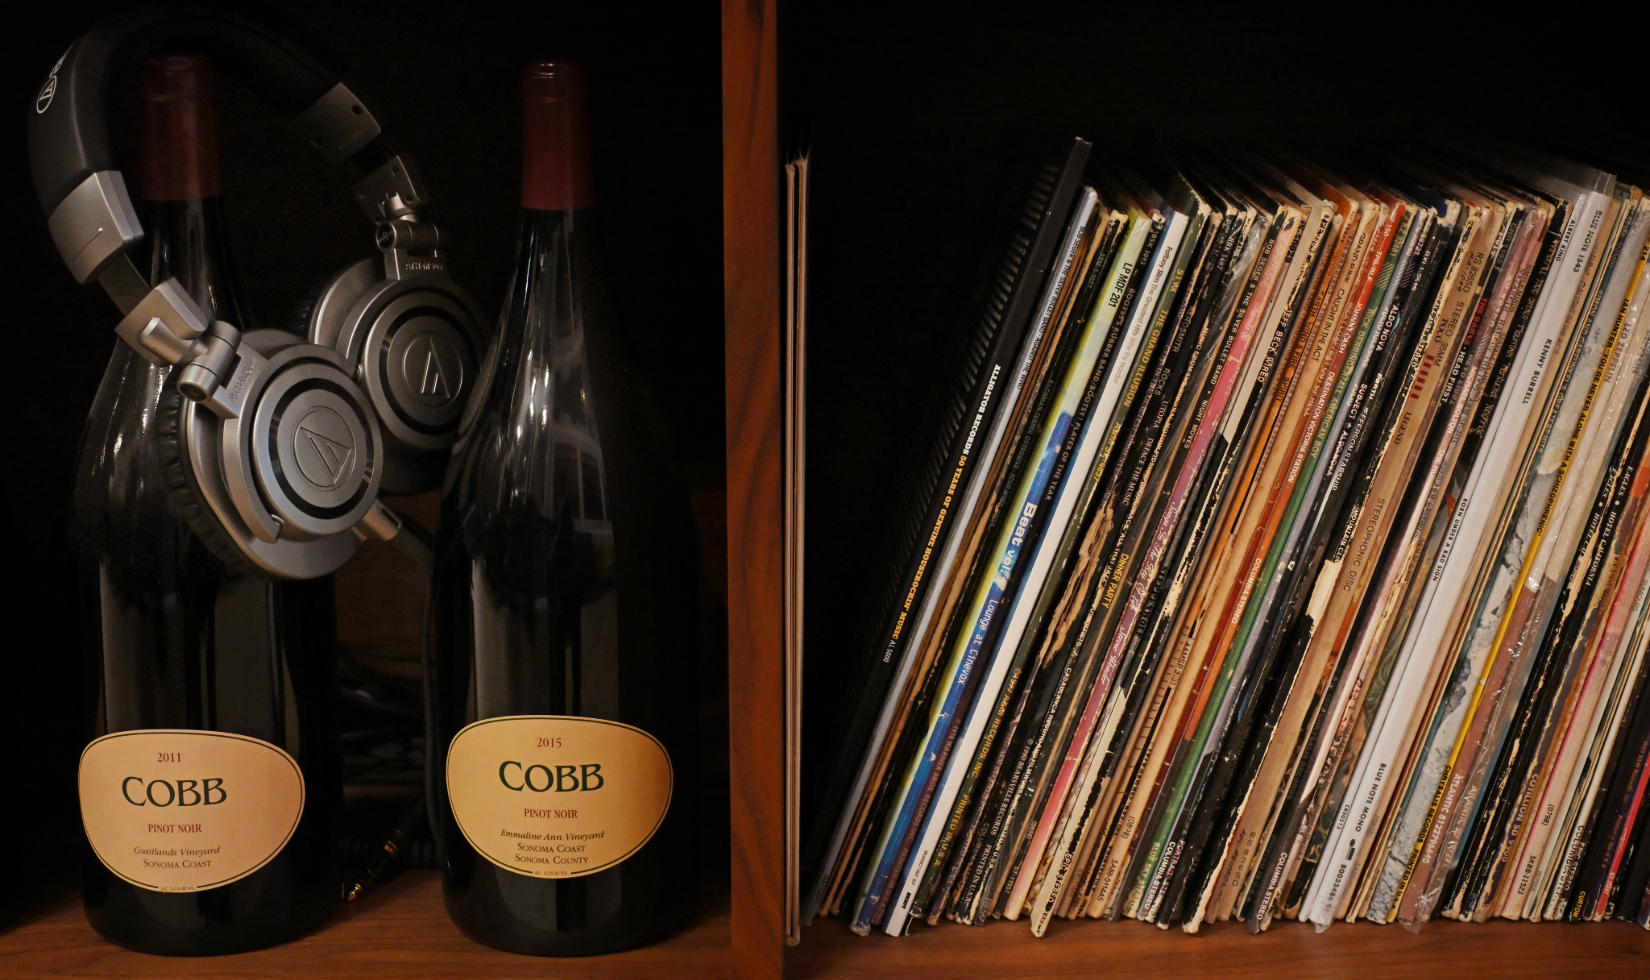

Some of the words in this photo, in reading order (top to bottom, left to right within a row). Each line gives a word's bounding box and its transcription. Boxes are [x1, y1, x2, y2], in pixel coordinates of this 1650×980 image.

[1561, 218, 1576, 244] ALBERT
[1588, 208, 1603, 231] BLUE
[1157, 244, 1173, 269] Fatboy
[1263, 237, 1275, 255] BOB
[1471, 250, 1484, 265] RS
[1554, 243, 1567, 263] KING
[1120, 261, 1133, 274] LP
[1214, 251, 1228, 271] 3487
[1251, 255, 1268, 282] SEGER
[1571, 253, 1586, 274] 1543
[1112, 272, 1129, 294] MDF
[1147, 282, 1158, 296] The
[1152, 267, 1164, 284] Slim
[1168, 267, 1185, 294] STYX
[1248, 282, 1256, 290] &
[1460, 264, 1478, 294] 826SD
[1107, 291, 1121, 308] 201
[1136, 295, 1153, 325] Greatest
[1241, 289, 1253, 307] THE
[1325, 286, 1346, 322] CAUGHT
[1475, 295, 1489, 315] THE
[1618, 297, 1630, 314] IAN
[1154, 308, 1169, 329] THE
[1229, 307, 1246, 334] SILVER
[1321, 320, 1333, 332] IN
[1360, 308, 1374, 329] RICK
[1383, 303, 1399, 328] ALDO
[1443, 299, 1464, 338] STEREO
[1101, 325, 1119, 359] RUBBER
[1131, 323, 1142, 337] Hits
[1266, 328, 1283, 355] BECK
[1316, 329, 1329, 346] THE
[1336, 331, 1351, 355] CASH
[1374, 326, 1390, 353] NOVA
[1432, 317, 1448, 344] POCO
[1462, 314, 1481, 347] BABYS
[1605, 313, 1624, 349] HUNTER
[1619, 322, 1632, 340] LED
[1120, 350, 1131, 363] Try
[1124, 336, 1136, 352] Why
[1140, 327, 1160, 364] GRAND
[1217, 334, 1235, 364] BULLET
[1309, 343, 1324, 362] ACT
[1432, 340, 1449, 368] 35MM
[1535, 337, 1553, 369] KENNY
[1112, 361, 1127, 385] Harder
[1255, 353, 1273, 384] WIRED
[1286, 350, 1301, 370] FIRE
[1450, 349, 1467, 377] HEAD
[1602, 340, 1625, 384] ZEPPELIN
[1122, 363, 1146, 408] ILLUSION
[1152, 366, 1171, 397] ROCKS
[1209, 363, 1223, 386] BAND
[1457, 364, 1478, 403] MICHAEL
[1521, 368, 1541, 406] BURRELL
[976, 363, 1002, 414] ALLIGATOR
[1273, 375, 1291, 404] SPIRIT
[1311, 370, 1336, 420] DESTINATION
[1346, 381, 1368, 421] SUBJECT
[1440, 375, 1456, 404] FIRST
[1581, 382, 1598, 412] NEVER
[1151, 398, 1169, 429] UTOPIA
[1193, 398, 1209, 423] NIGHT
[1316, 395, 1339, 439] AMERICAN
[1445, 402, 1463, 435] BOLTON
[960, 413, 983, 456] RECORDS
[1064, 421, 1081, 451] PLAYER
[1182, 422, 1199, 451] MOVES
[1298, 418, 1317, 454] VICTORIA
[1392, 410, 1412, 446] LEGEND
[1570, 411, 1587, 440] ALONE
[956, 454, 968, 468] 50
[1059, 450, 1069, 463] OF
[1136, 435, 1154, 466] DEFACE
[1308, 439, 1322, 459] BOY
[1562, 439, 1577, 462] WITH
[1052, 462, 1064, 480] THE
[1130, 464, 1143, 482] THE
[1286, 452, 1304, 484] STATION
[1559, 461, 1568, 469] A
[945, 466, 963, 496] YEARS
[1043, 479, 1057, 501] YEAR
[1120, 480, 1136, 506] MUSIC
[1600, 466, 1618, 498] EAGLES
[1615, 464, 1634, 497] EAGLES
[940, 494, 952, 509] OF
[1159, 499, 1180, 529] Songs
[1456, 496, 1469, 517] BORN
[1533, 467, 1566, 537] SCHIZOPHRENIC"
[925, 507, 947, 548] GENUINE
[1009, 500, 1038, 548] Beat
[1154, 528, 1168, 542] In
[1351, 496, 1386, 568] STEREOPHONIC
[1446, 517, 1461, 541] UNDER
[1584, 511, 1600, 540] HOTEL
[1600, 510, 1618, 539] HOTEL
[1147, 541, 1163, 561] The
[1438, 548, 1449, 564] BAD
[900, 546, 932, 611] HOUSEROCKIN'
[1110, 552, 1129, 583] DINNER
[1139, 560, 1156, 582] Key
[1241, 556, 1262, 596] COLUMBIA
[1342, 569, 1357, 593] DISC
[1431, 563, 1443, 582] SIGN
[1100, 581, 1118, 610] PARTY
[1133, 581, 1148, 596] Of
[976, 597, 998, 632] Lounge
[1127, 593, 1143, 612] Life
[1230, 594, 1247, 625] STEREO
[889, 610, 907, 640] MUSIC
[973, 633, 984, 646] at
[1110, 625, 1130, 654] Stevie
[956, 647, 979, 686] Cinevox
[1097, 652, 1119, 687] Wonder
[995, 693, 1010, 717] A&M
[536, 737, 562, 748] 2015
[156, 752, 182, 763] 2011
[499, 760, 604, 793] COBB
[1001, 760, 1025, 803] BEARSVILLE
[1372, 761, 1387, 784] BLUE
[1429, 763, 1452, 809] CHRYSALIS
[121, 776, 227, 808] COBB
[1363, 782, 1379, 806] NOTE
[1440, 772, 1463, 814] ATLANTIC
[1514, 771, 1540, 822] COTILLION
[524, 808, 551, 818] PINOT
[554, 809, 578, 818] NOIR
[947, 793, 969, 832] PRINTED
[988, 801, 1008, 836] RECORDS
[1353, 805, 1370, 833] MONO
[1416, 806, 1435, 844] RECORDS
[147, 823, 175, 833] PINOT
[177, 823, 202, 833] NOIR
[500, 828, 542, 840] Emmaline
[543, 833, 563, 841] Ann
[565, 830, 605, 842] Vineyard
[943, 831, 953, 842] IN
[1508, 822, 1520, 837] SD
[133, 846, 177, 856] Coastlands
[179, 845, 221, 857] Vineyard
[973, 842, 992, 875] PRINTED
[1145, 839, 1161, 863] BLUE
[1153, 839, 1177, 882] COLUMBIA
[1401, 847, 1420, 882] PRINTED
[970, 873, 980, 884] IN
[1139, 861, 1153, 879] SKY
[1266, 850, 1288, 891] COLUMBIA
[1142, 879, 1161, 911] STEREO
[1398, 880, 1407, 890] IN
[1254, 890, 1273, 921] STEREO
[1570, 889, 1587, 918] CURTOM
